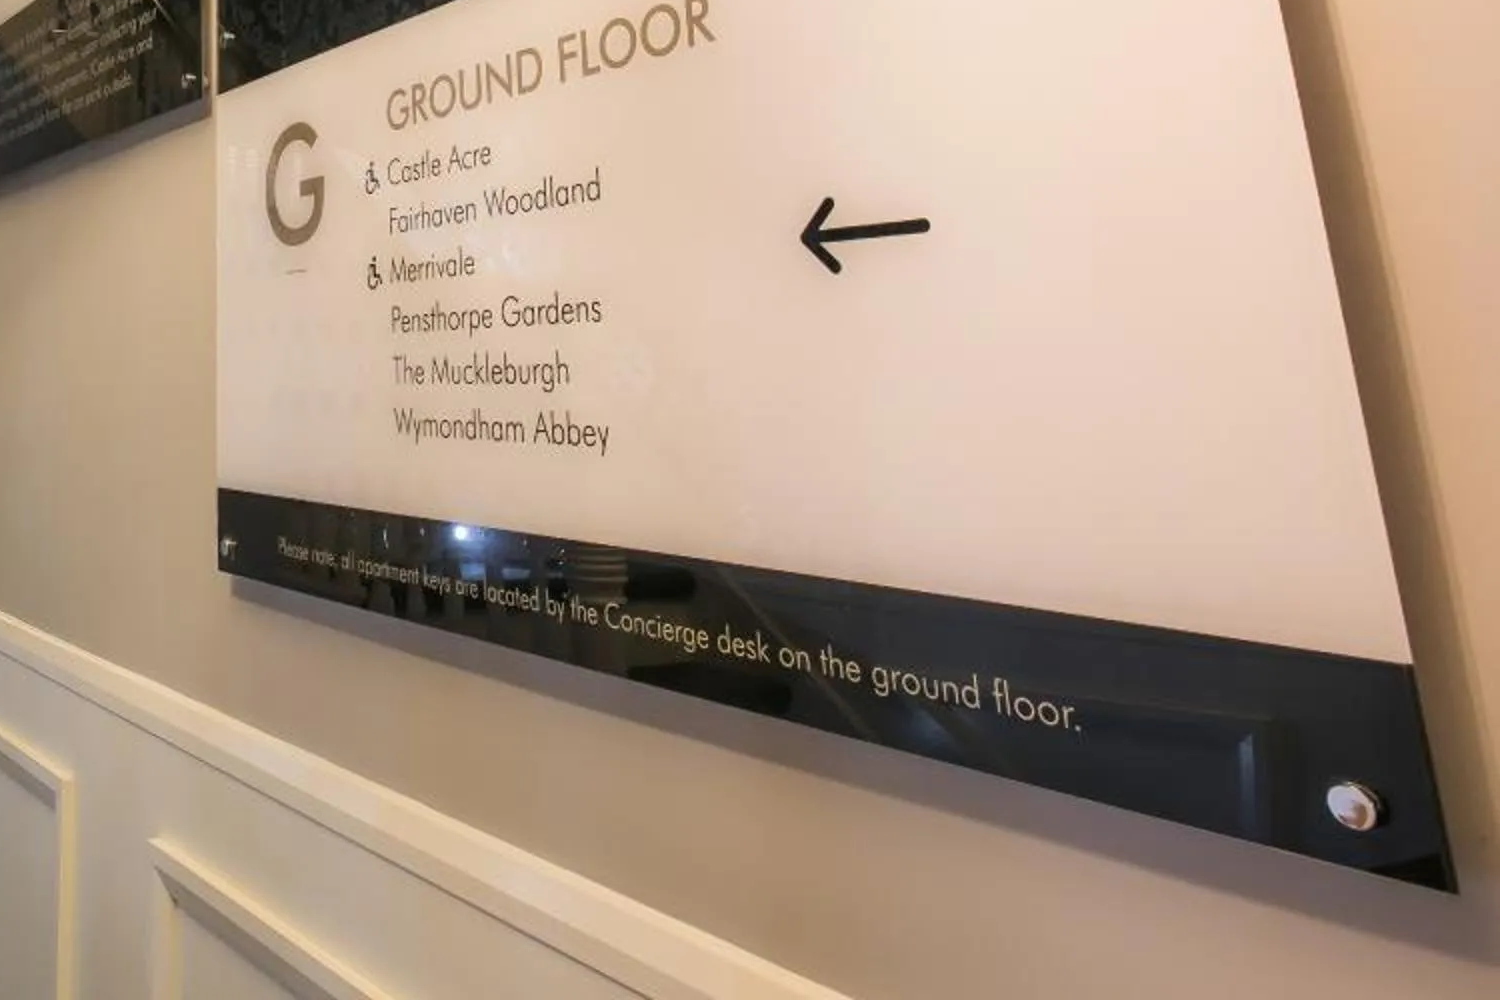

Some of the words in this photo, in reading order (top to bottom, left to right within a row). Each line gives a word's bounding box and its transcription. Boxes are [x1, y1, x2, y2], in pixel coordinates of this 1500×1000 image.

[386, 46, 543, 131] GROUND
[265, 121, 326, 246] G
[386, 148, 442, 186] Castle
[446, 143, 492, 176] Acre
[388, 199, 477, 235] Fairhaven
[482, 166, 602, 218] Woodland
[389, 246, 476, 285] Merrivale
[390, 299, 494, 338] Pensthorpe
[500, 291, 602, 328] Gardens
[392, 354, 425, 386] The
[430, 350, 570, 394] Muckleburgh
[392, 407, 526, 446] Wymondham
[532, 412, 610, 456] Abbey
[277, 536, 309, 562] Please
[340, 551, 355, 570] all
[356, 558, 421, 586] apartment
[422, 563, 451, 598] keys
[454, 579, 480, 600] are
[482, 575, 540, 613] located
[544, 588, 566, 624] by
[570, 595, 599, 626] the
[602, 601, 710, 653] Concierge
[716, 623, 771, 664] desk
[778, 646, 812, 673] on
[819, 642, 862, 683] the
[870, 665, 981, 710] ground
[991, 677, 1083, 733] floor.
